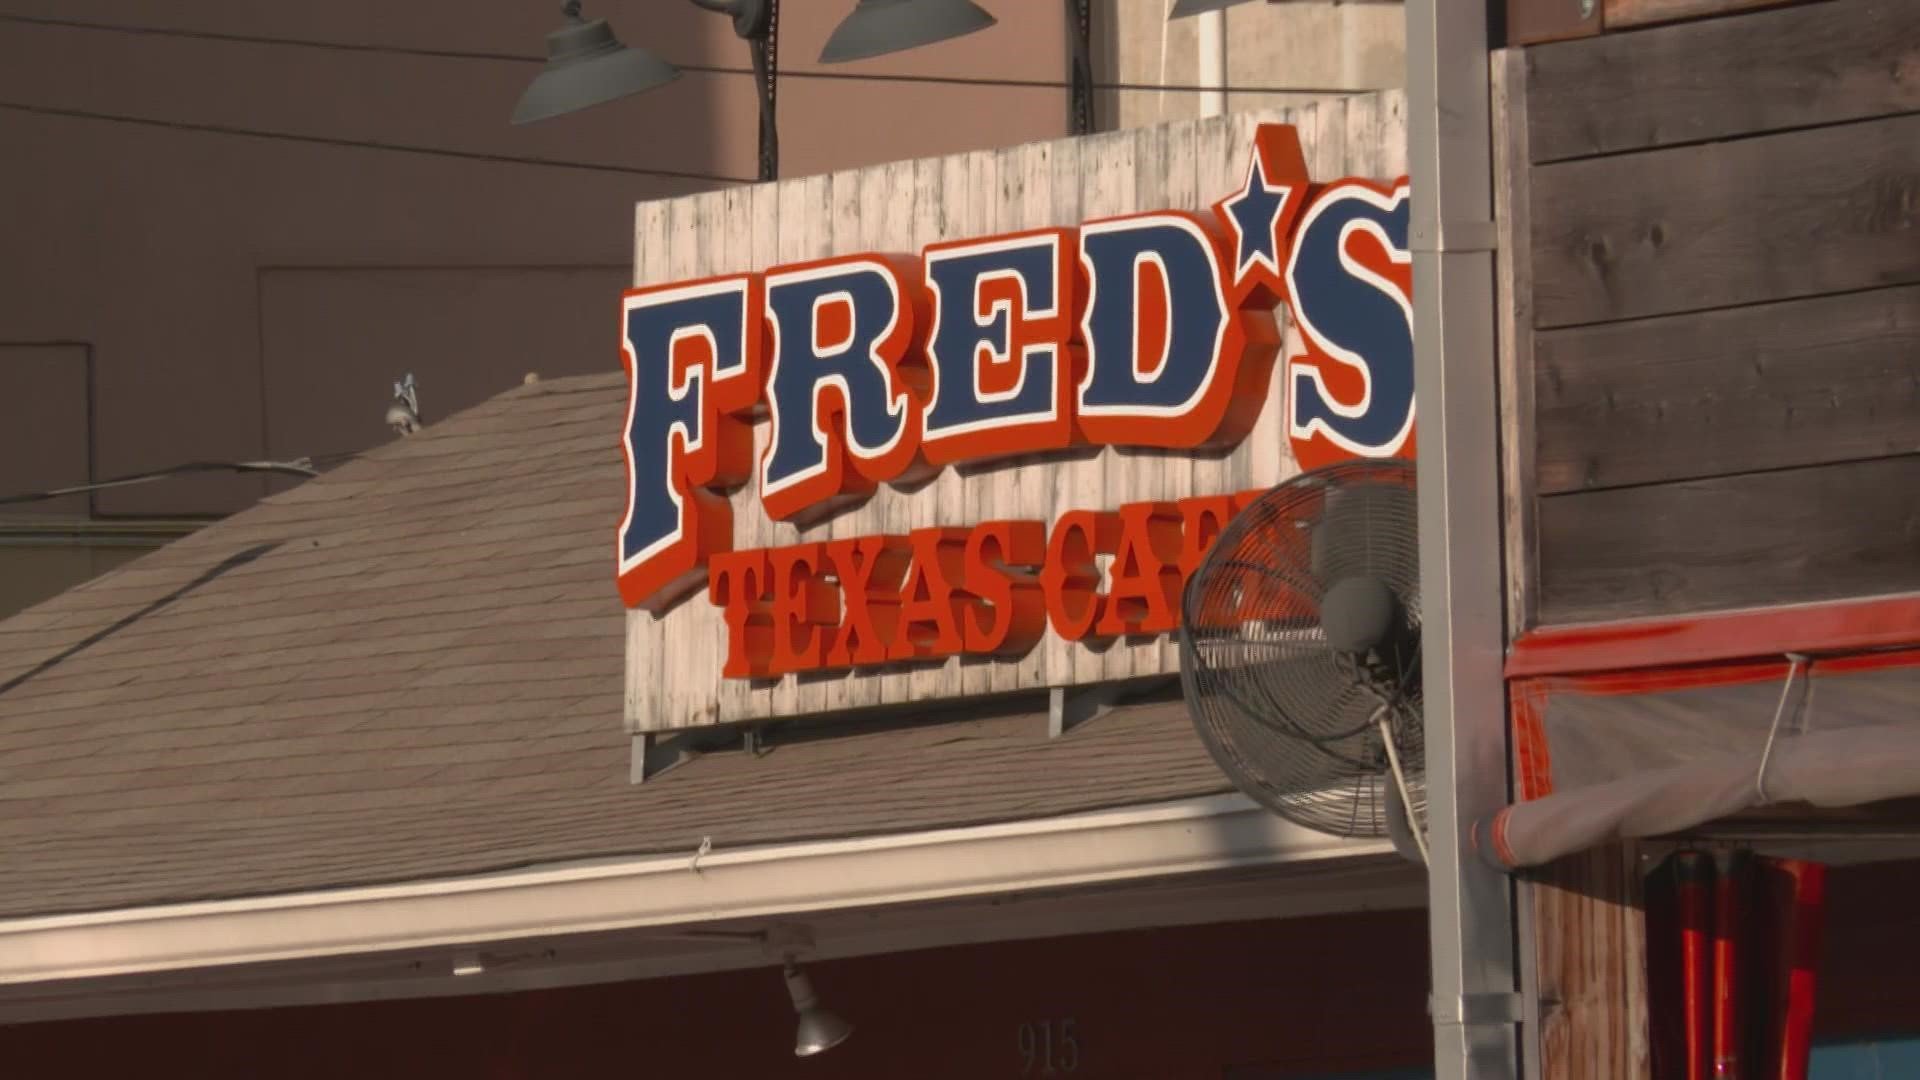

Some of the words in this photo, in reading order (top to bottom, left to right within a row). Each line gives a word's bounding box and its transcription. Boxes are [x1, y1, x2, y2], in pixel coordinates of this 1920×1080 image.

[618, 124, 1415, 608] FRED'S
[709, 513, 1046, 679] TEXAS
[1018, 1017, 1079, 1077] 915
